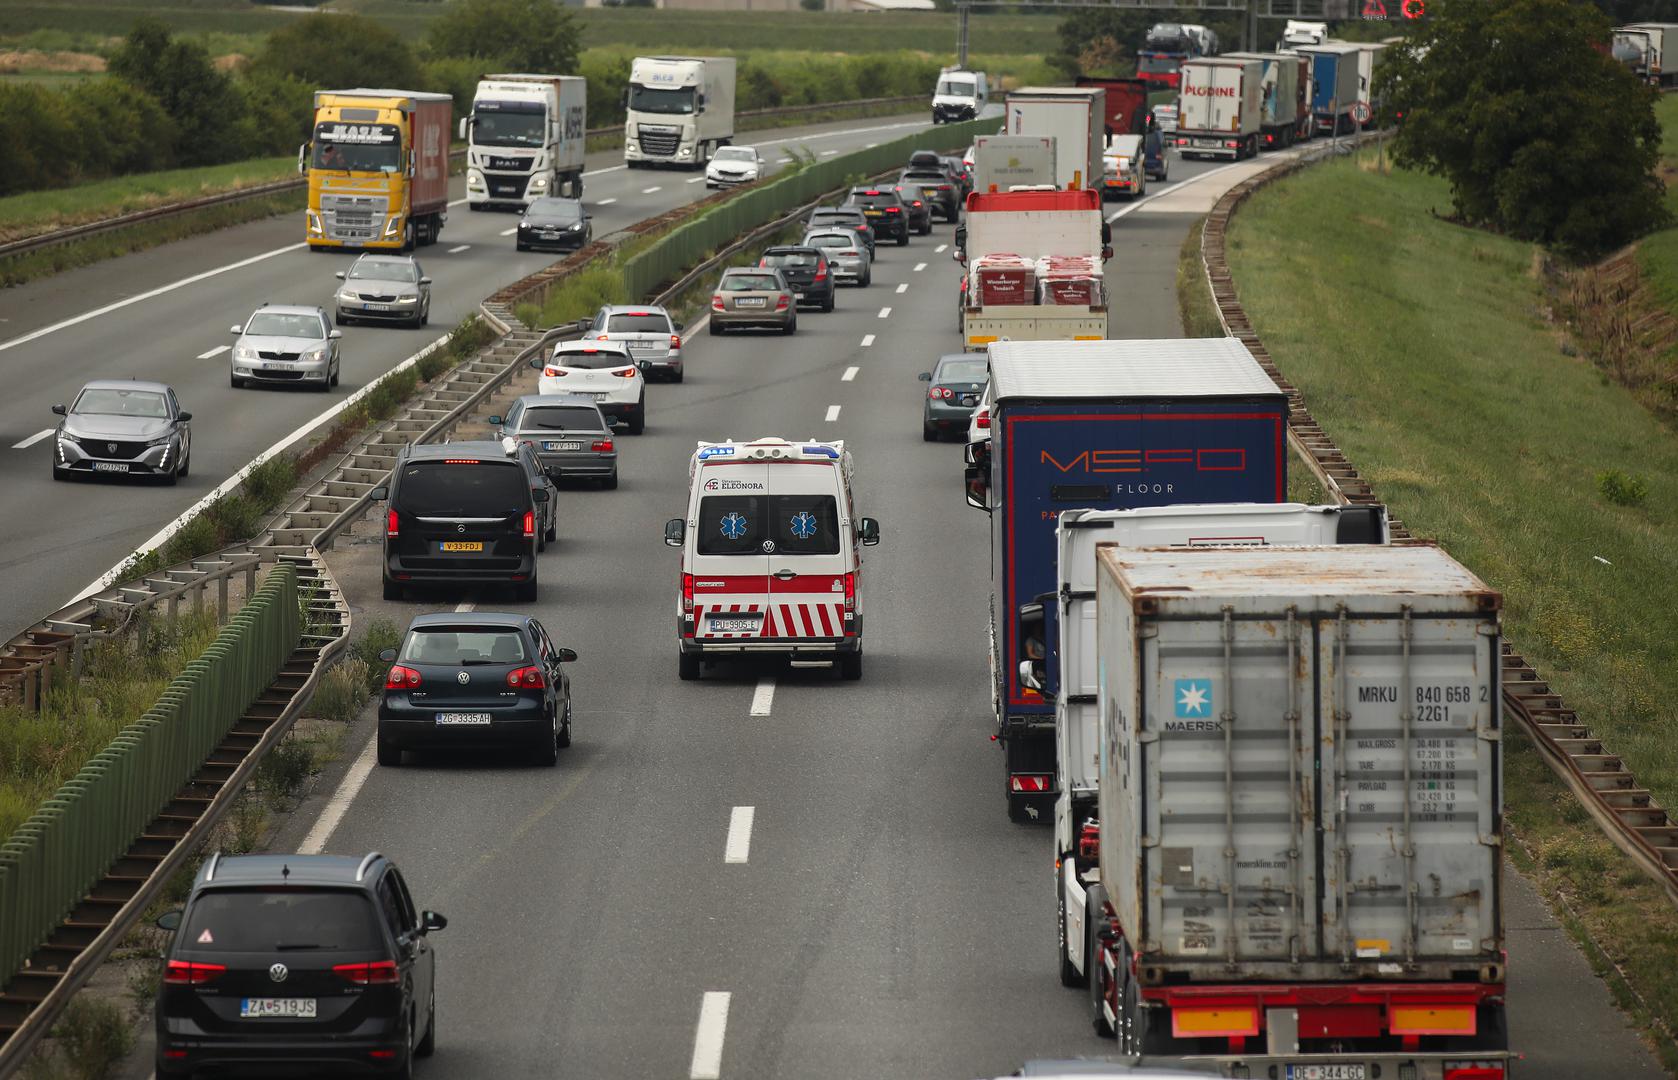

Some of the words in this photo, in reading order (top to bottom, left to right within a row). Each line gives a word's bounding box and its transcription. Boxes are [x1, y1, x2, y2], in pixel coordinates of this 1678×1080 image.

[1184, 86, 1235, 97] PLODINE
[1116, 484, 1174, 494] FLOOR
[1358, 686, 1398, 703] MRKU
[1416, 686, 1441, 703] 840
[1446, 686, 1471, 703] 658
[1417, 705, 1449, 722] 22G1
[1165, 721, 1224, 731] MAERSK
[1358, 761, 1375, 769] TARE
